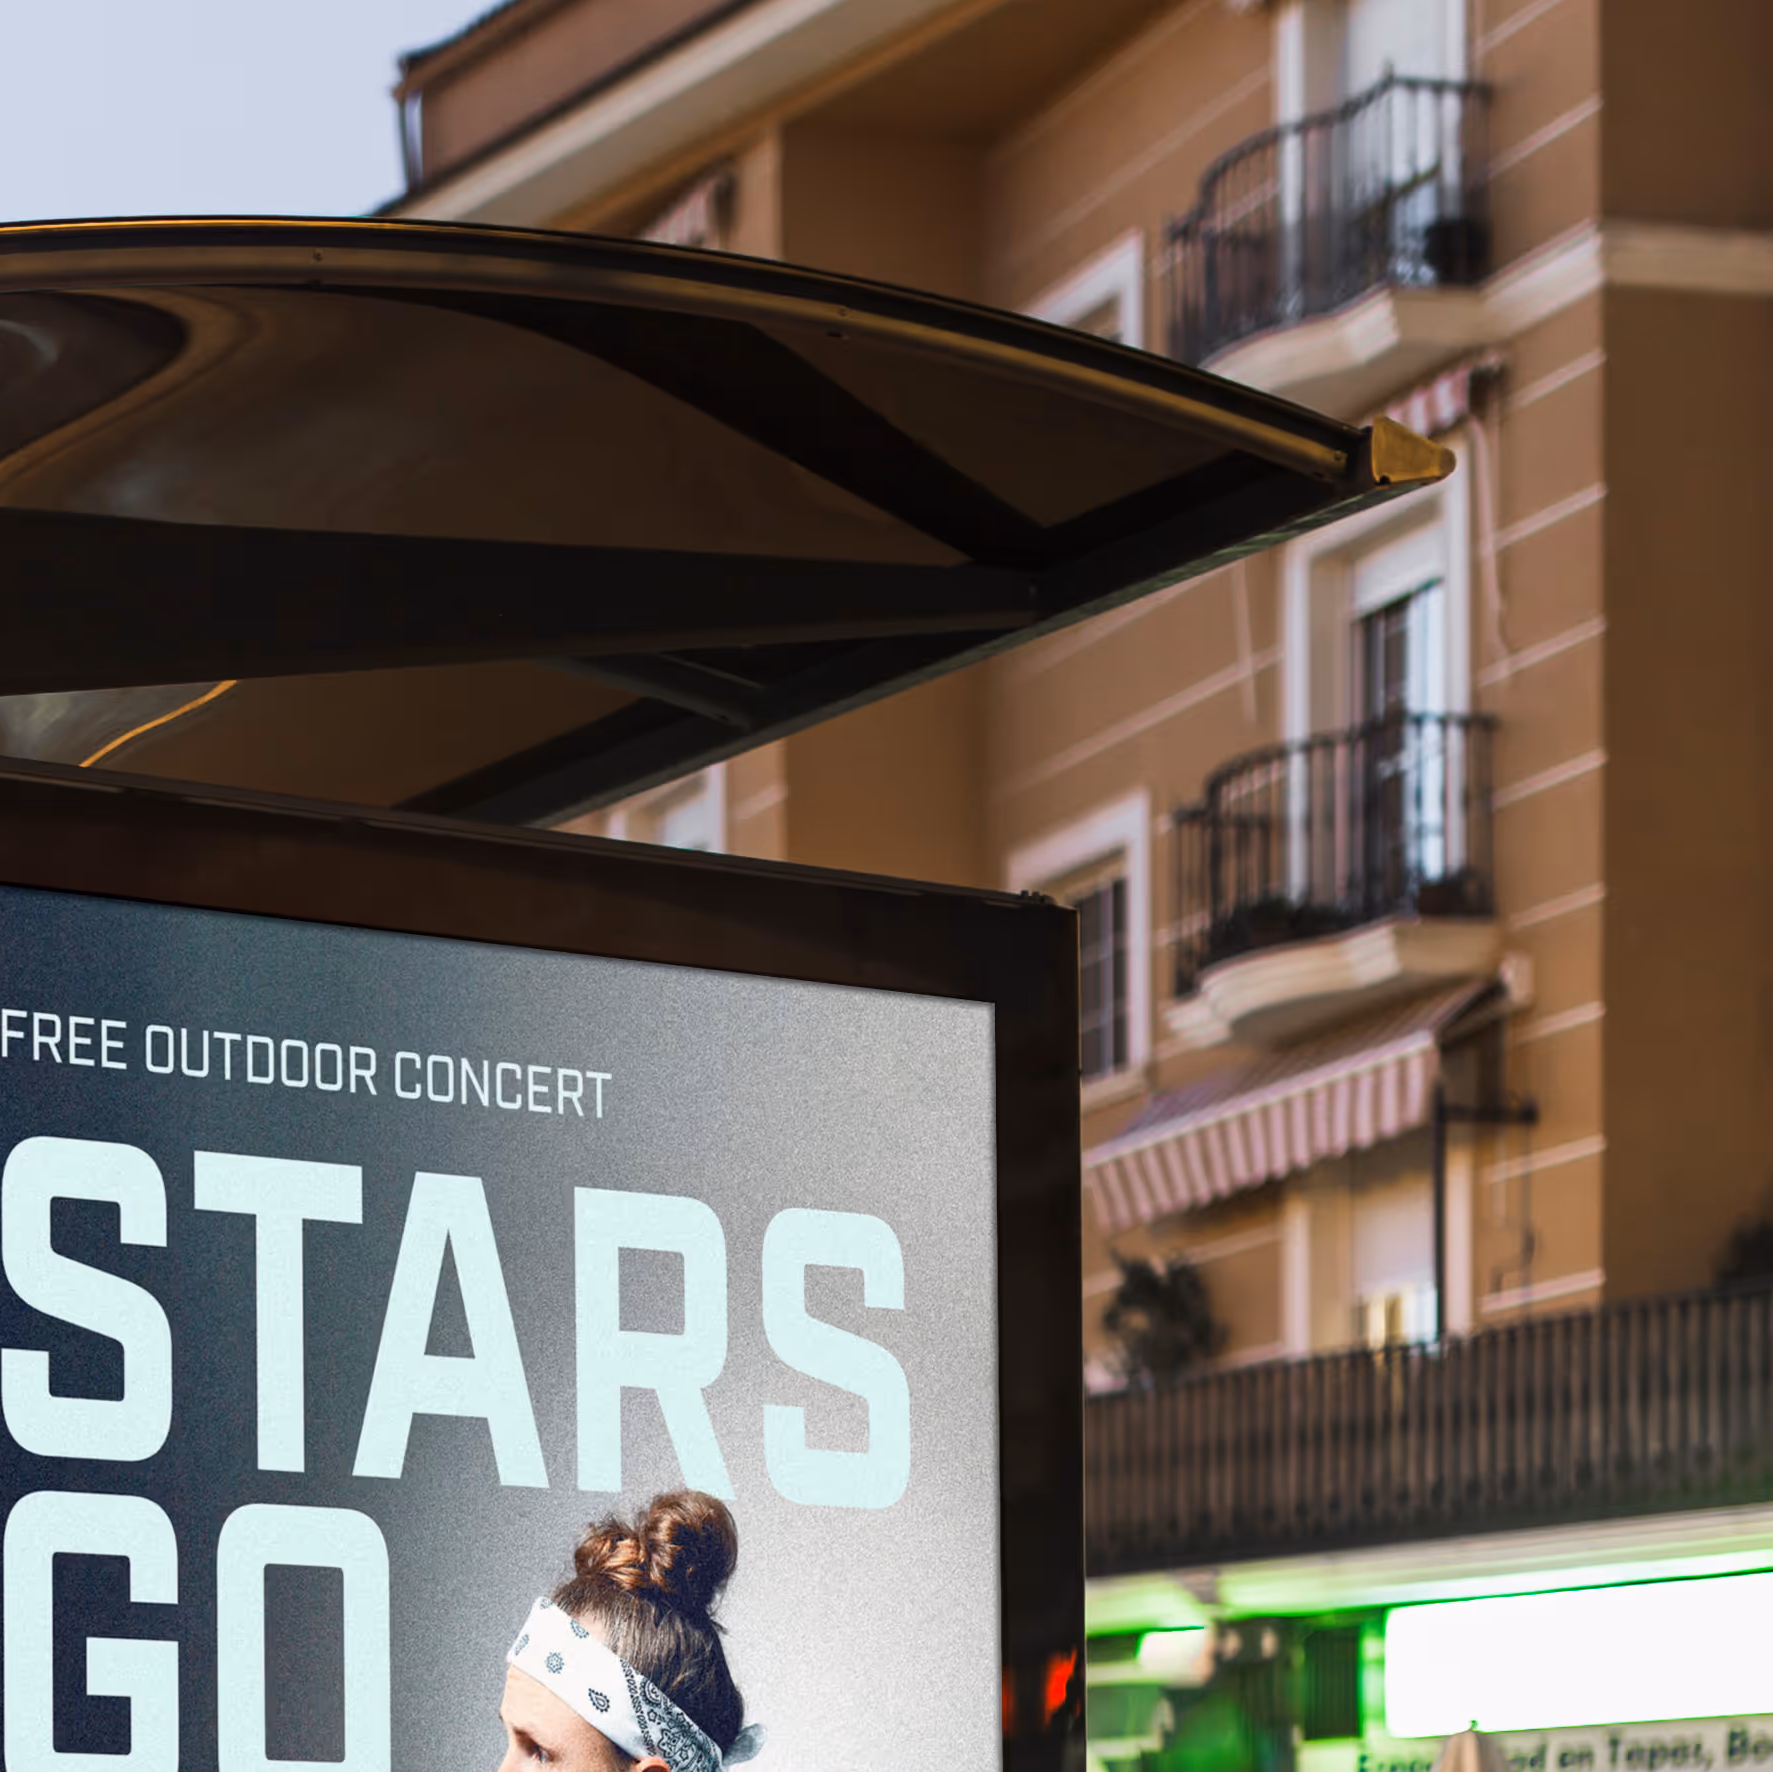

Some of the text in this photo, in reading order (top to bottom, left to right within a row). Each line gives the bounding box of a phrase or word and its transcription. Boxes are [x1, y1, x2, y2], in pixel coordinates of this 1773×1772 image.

[0, 1007, 612, 1118] FREE OUTDOOR CONCERT
[1, 1135, 911, 1511] STARS
